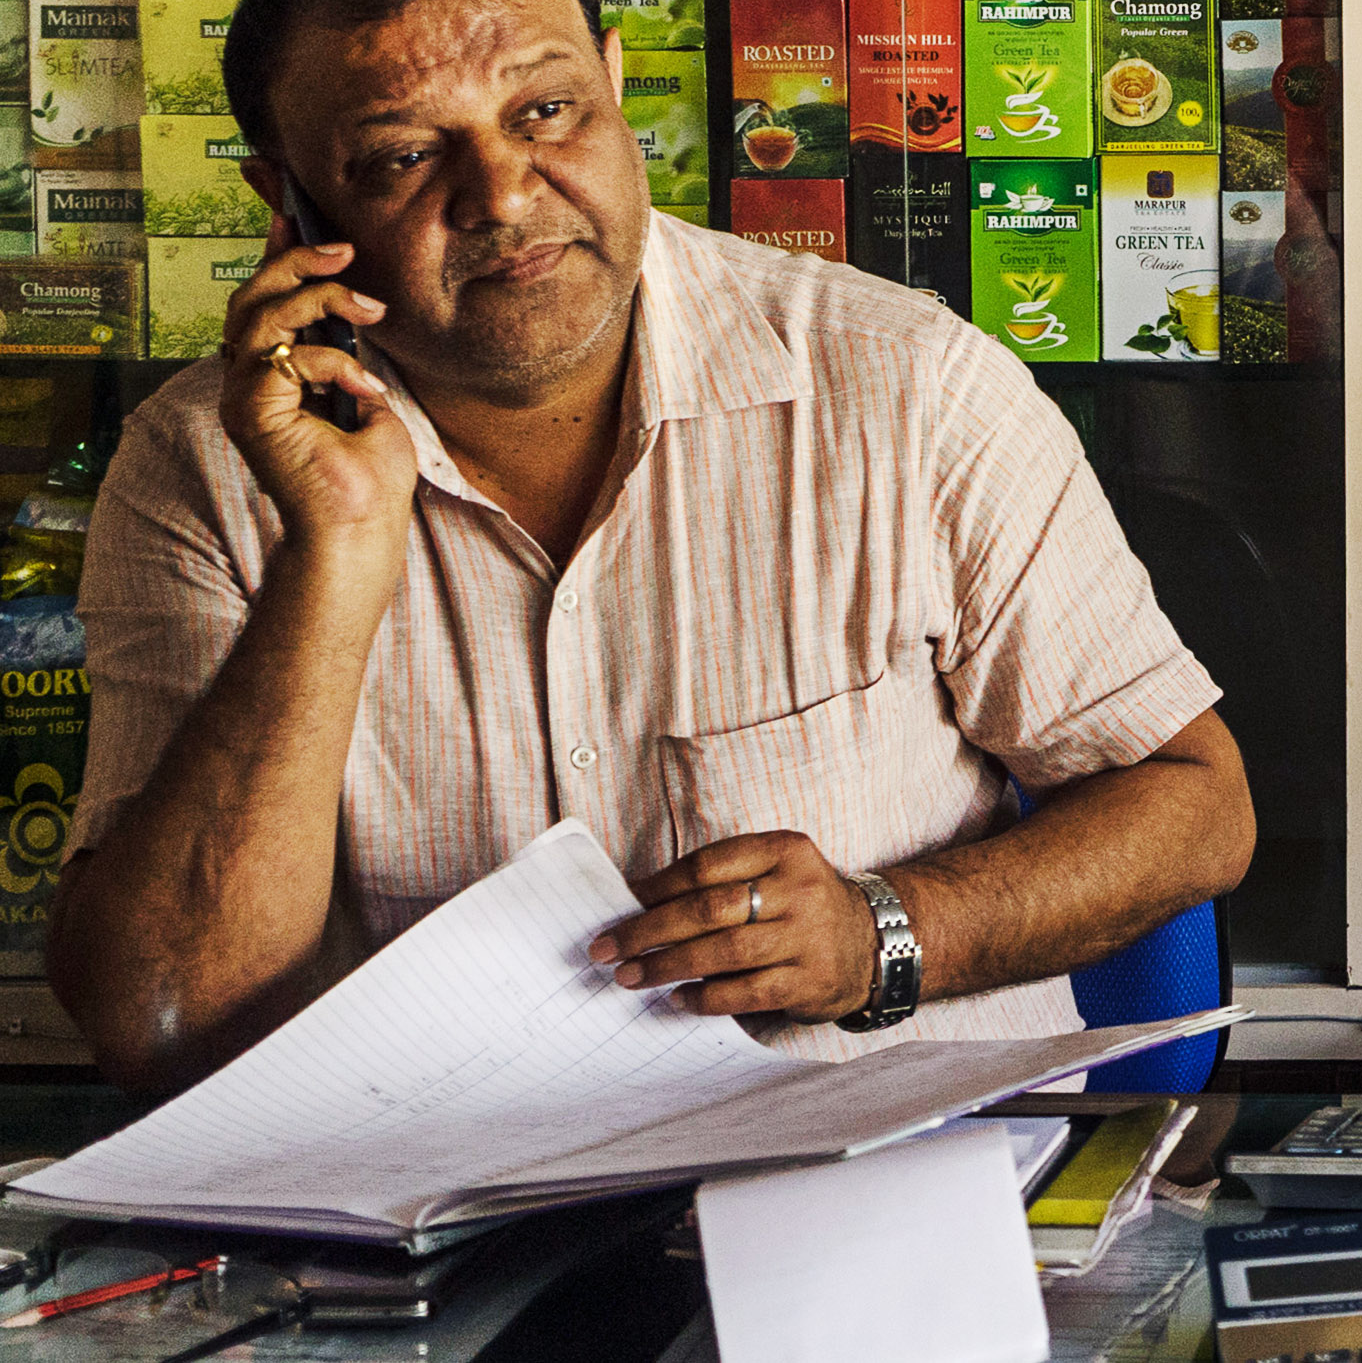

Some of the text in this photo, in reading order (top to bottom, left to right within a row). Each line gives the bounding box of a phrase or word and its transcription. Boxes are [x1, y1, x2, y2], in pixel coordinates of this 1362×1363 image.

[981, 5, 1071, 20] RAHIMPUR
[1110, 0, 1201, 21] Chamong
[922, 34, 956, 46] HILL
[1121, 27, 1188, 38] Popular Green
[743, 45, 834, 62] ROASTED
[1134, 199, 1186, 210] MARAPUR
[1116, 235, 1205, 250] GREEN TEA
[1139, 252, 1184, 272] Classic
